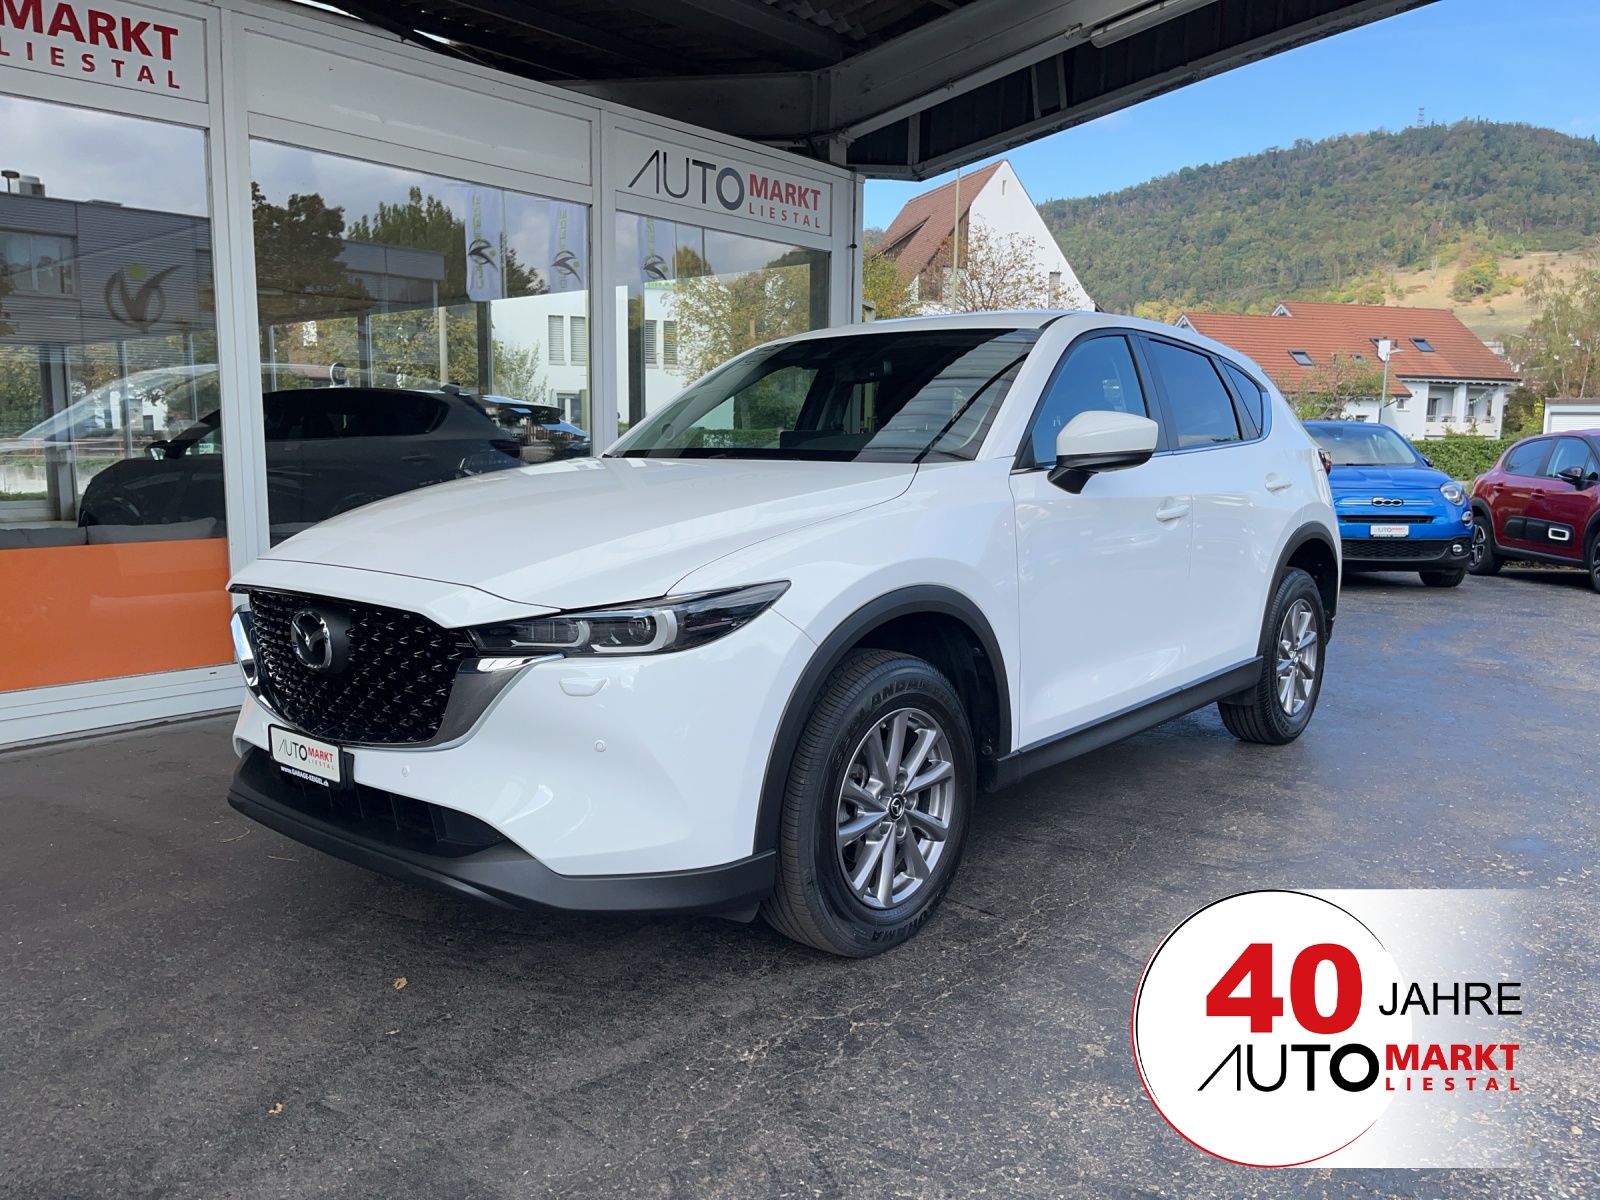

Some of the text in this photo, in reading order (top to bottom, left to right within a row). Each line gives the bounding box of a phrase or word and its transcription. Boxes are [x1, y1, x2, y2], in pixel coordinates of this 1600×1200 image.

[0, 0, 178, 60] MARKT
[0, 36, 180, 89] LIESTAL
[749, 202, 821, 228] LIESTAL
[1372, 497, 1403, 507] 500
[308, 759, 334, 771] LIESTAL
